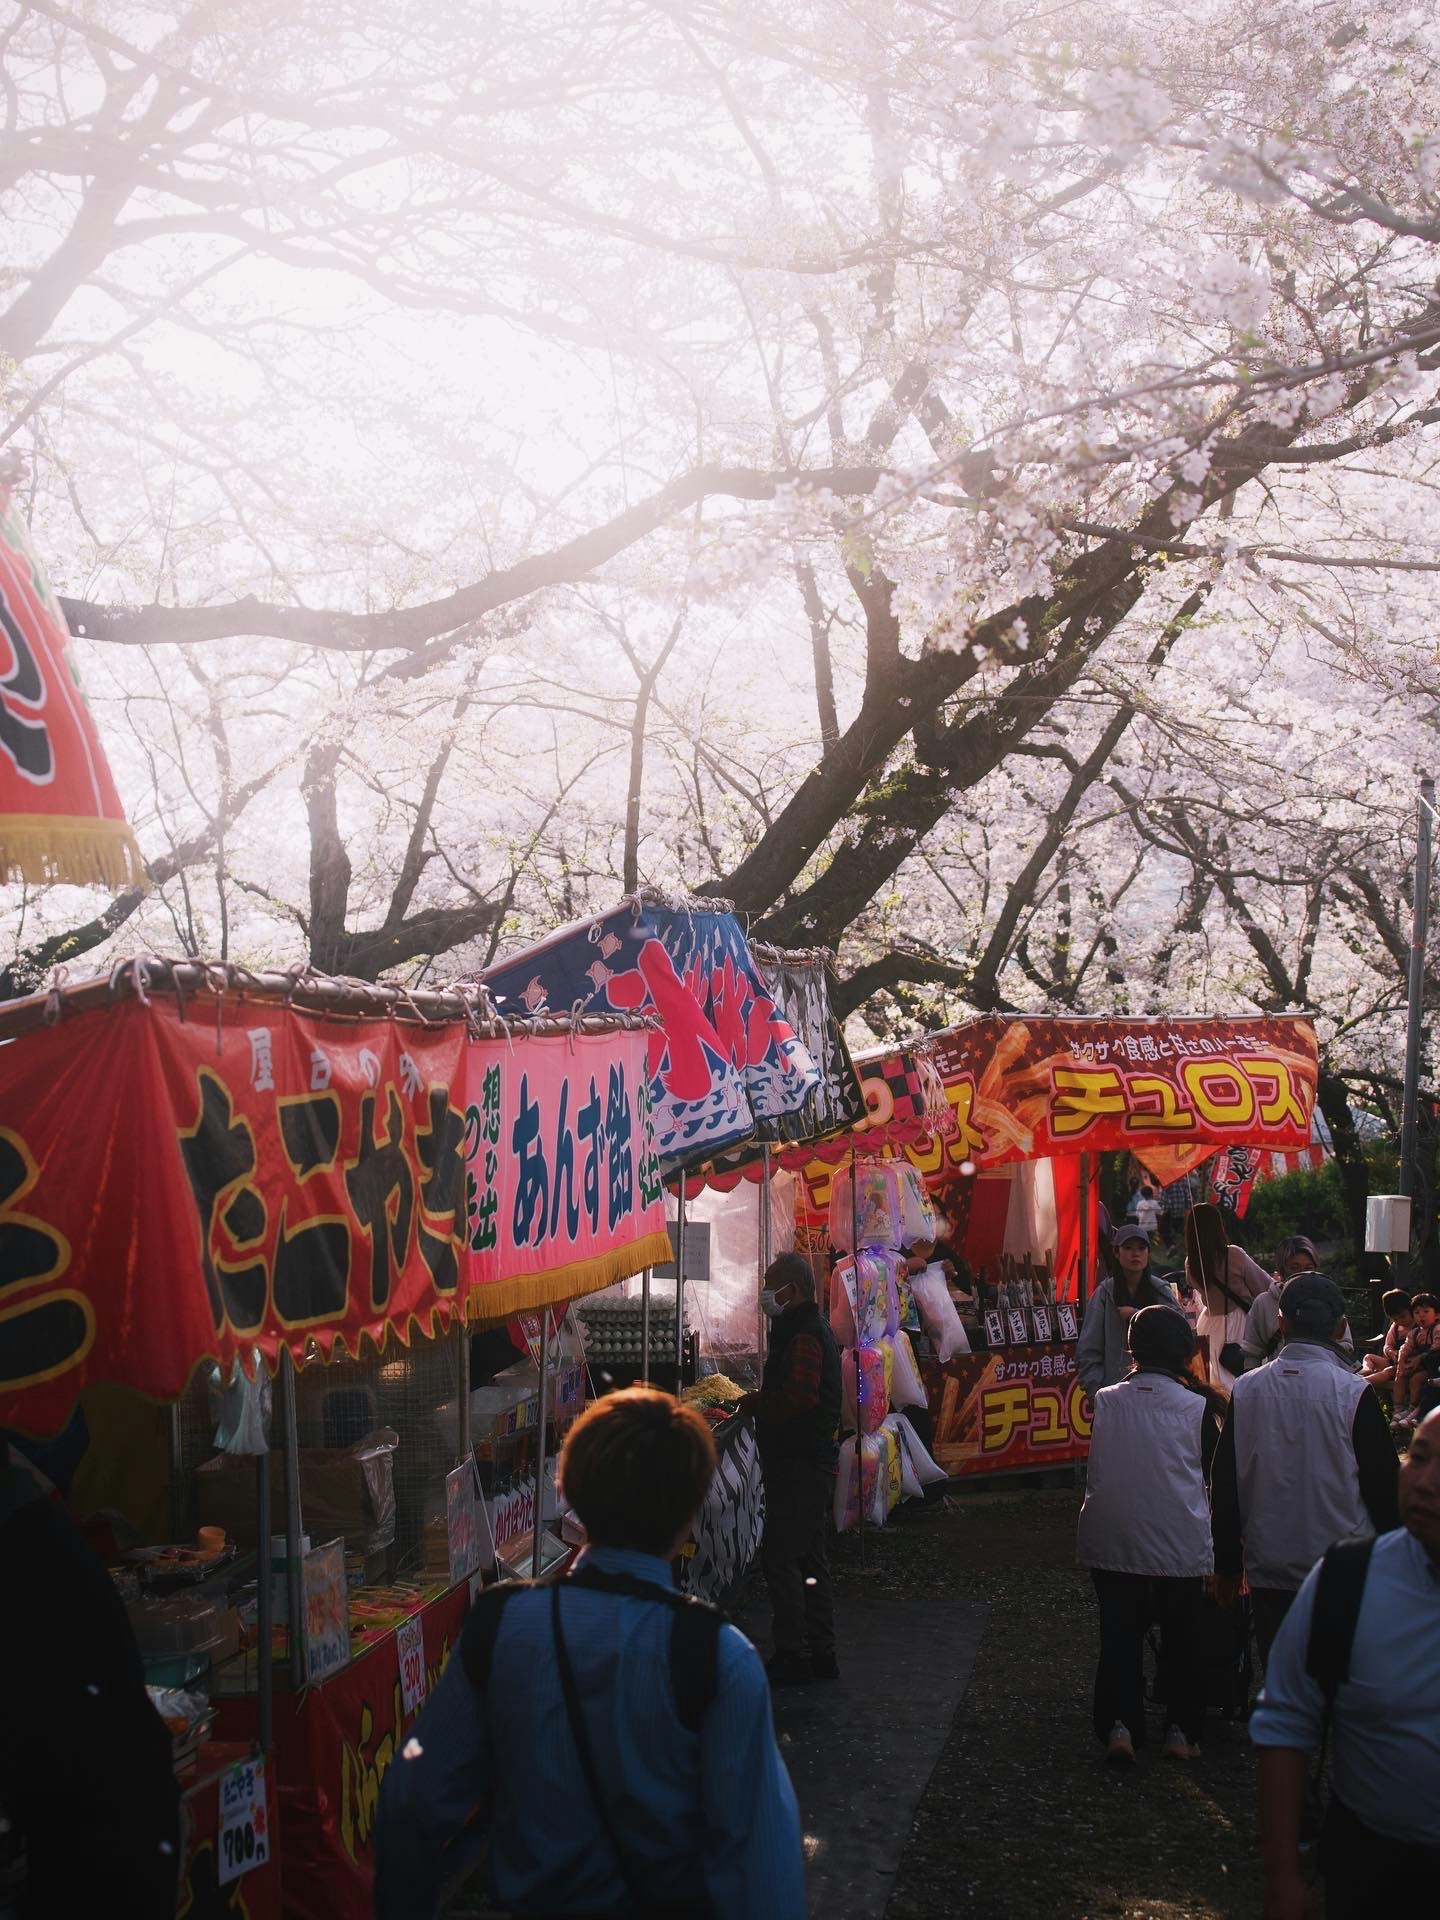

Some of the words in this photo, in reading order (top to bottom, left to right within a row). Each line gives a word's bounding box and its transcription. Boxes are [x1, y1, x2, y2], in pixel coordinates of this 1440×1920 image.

[472, 1063, 501, 1251] 想ひ出
[512, 1060, 633, 1247] あんず飴
[1049, 1057, 1308, 1137] チュロス
[176, 1063, 466, 1339] たこやき
